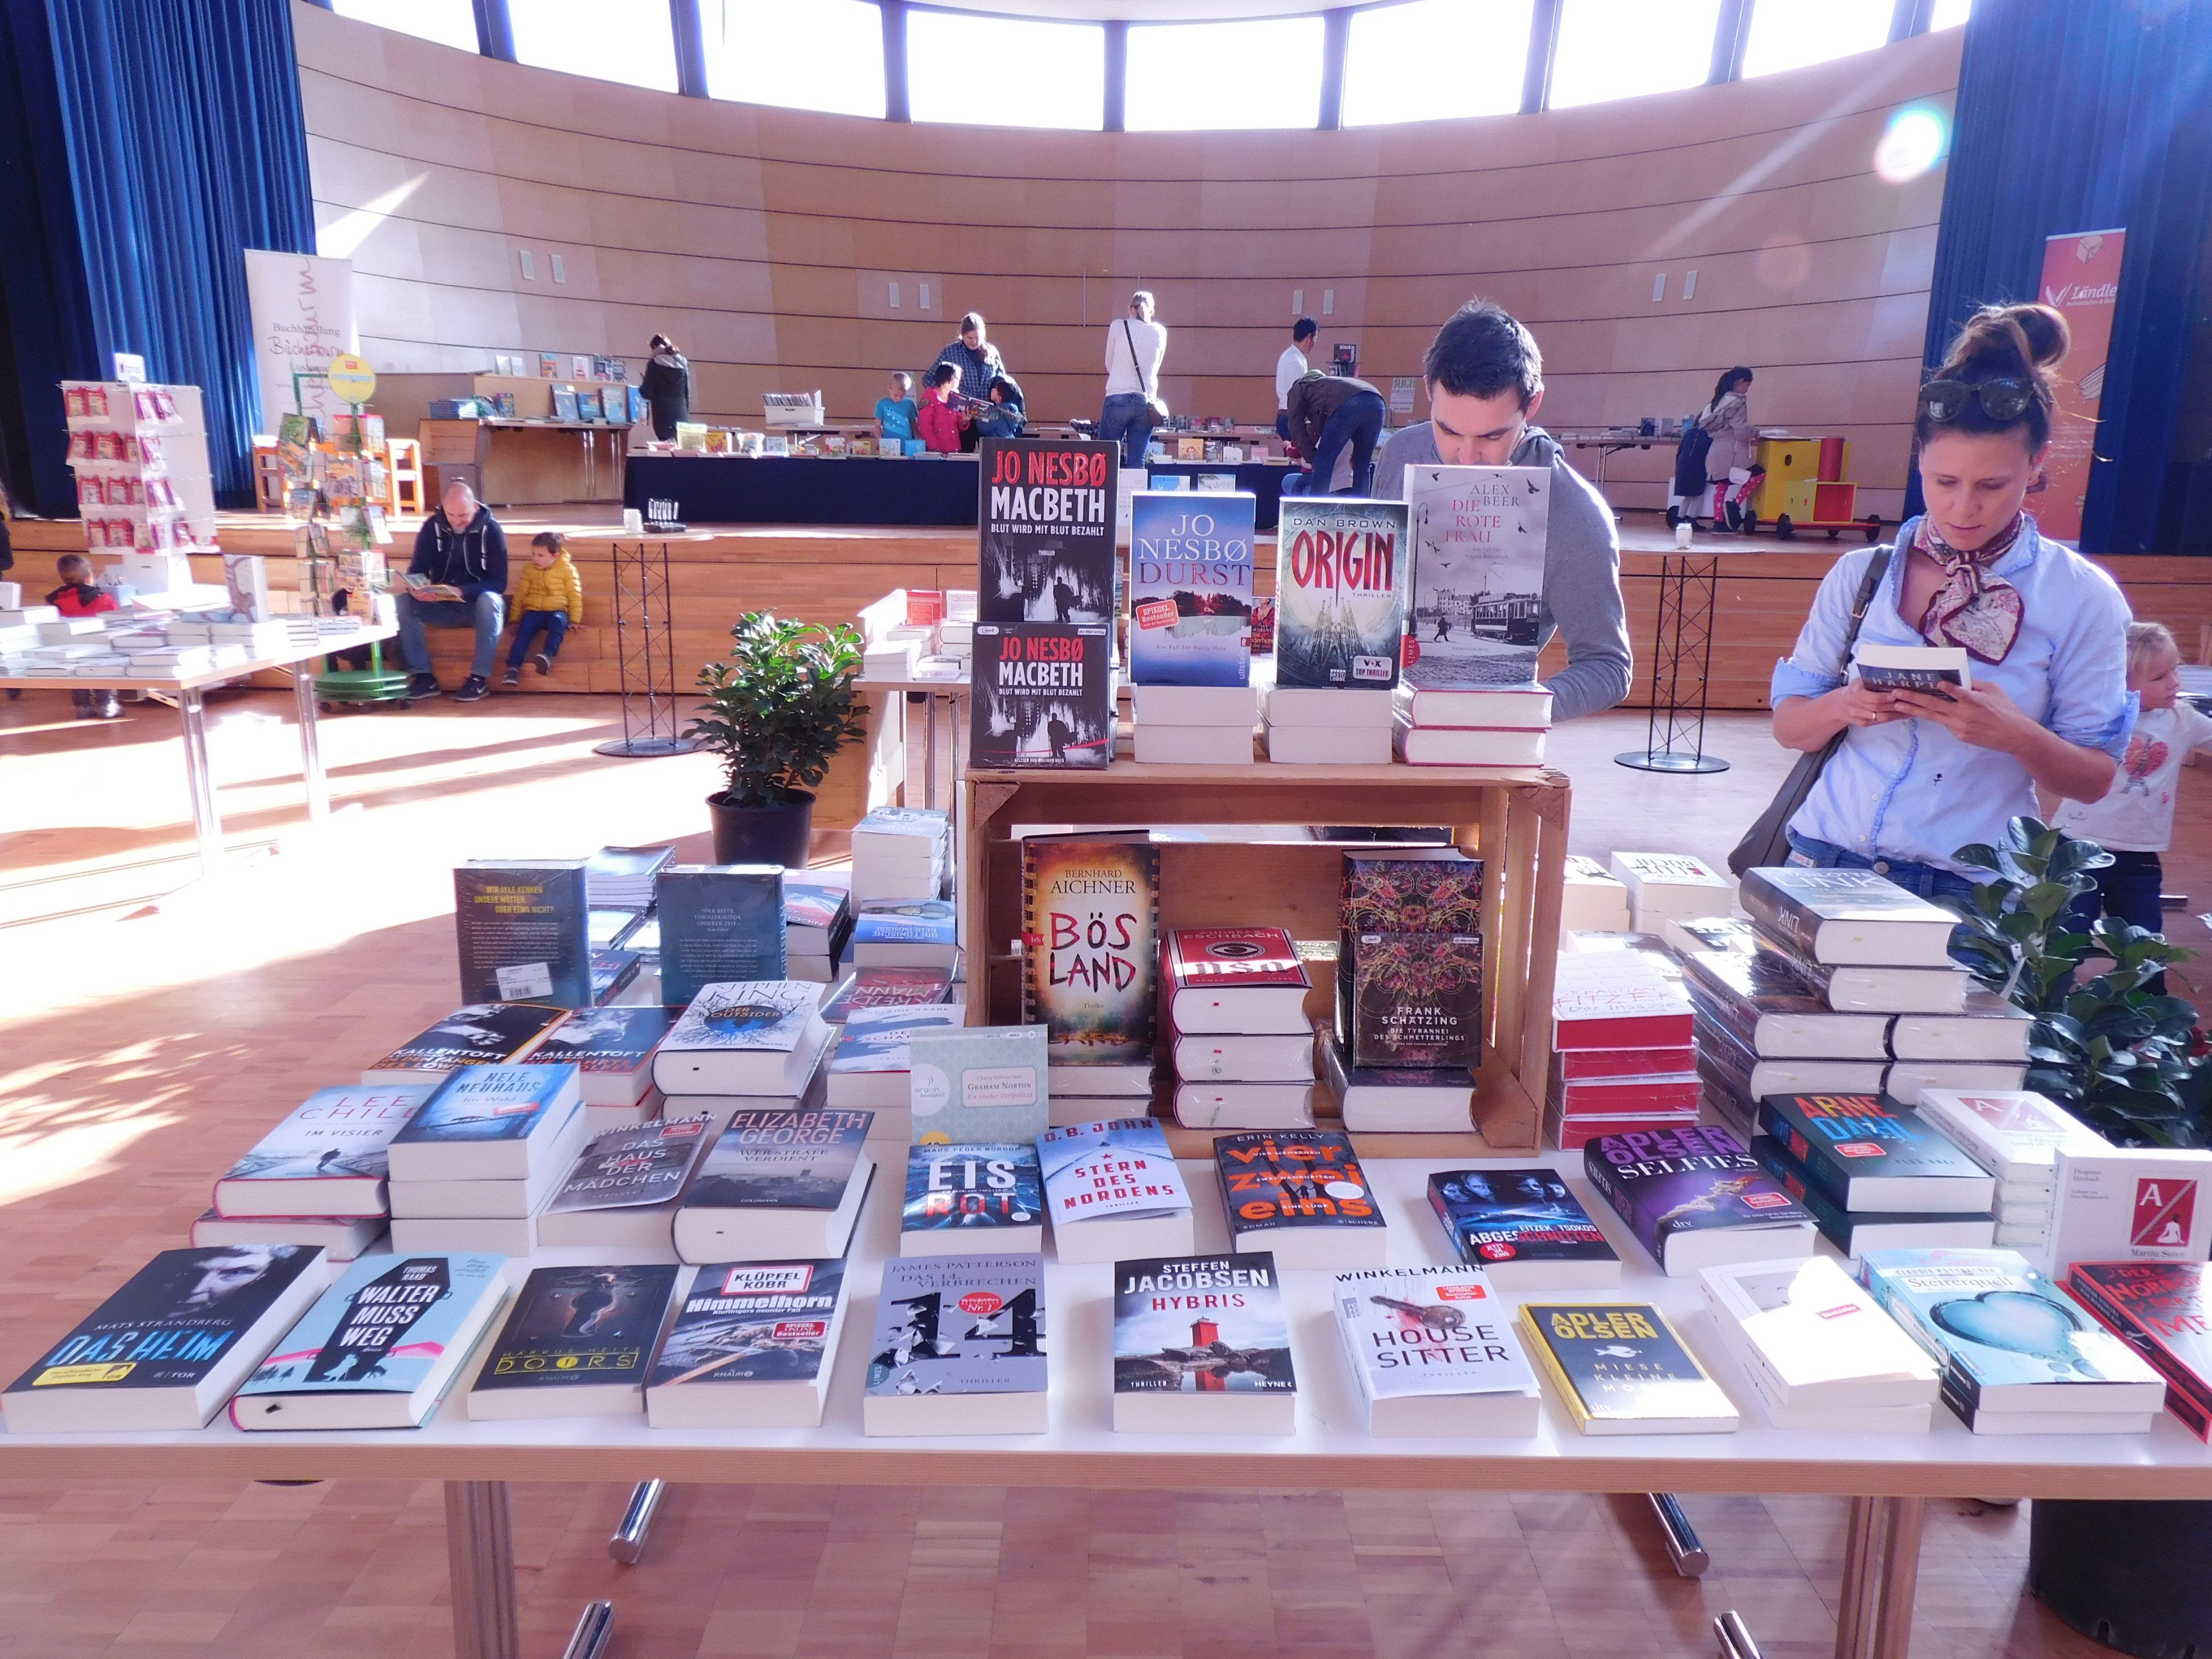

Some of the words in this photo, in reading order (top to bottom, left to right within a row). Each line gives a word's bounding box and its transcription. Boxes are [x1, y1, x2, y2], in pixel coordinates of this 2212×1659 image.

[2071, 284, 2117, 300] Ländle
[273, 323, 340, 336] Buchhandlung
[991, 450, 1021, 484] JO
[1028, 451, 1107, 487] NESBØ
[1471, 484, 1510, 495] ALEX
[991, 486, 1105, 523] MACBETH
[1453, 499, 1480, 512] DIE
[1483, 496, 1520, 507] BEER
[1171, 514, 1215, 537] JO
[1293, 518, 1326, 527] DAN
[1337, 519, 1395, 529] BROWN
[1456, 515, 1501, 528] ROTE
[991, 524, 1009, 534] BLUT
[1012, 524, 1033, 535] WIRD
[1035, 525, 1048, 535] MIT
[1050, 525, 1069, 535] BLUT
[1071, 526, 1104, 536] BEZAHLT
[1445, 530, 1492, 543] FRAU
[1137, 538, 1247, 563] NESBØ
[1139, 563, 1251, 586] DURST
[1291, 529, 1395, 606] ORIGIN
[1142, 611, 1174, 623] Bestseller
[1143, 604, 1170, 616] SPIEGEL
[999, 637, 1021, 660] JO
[1027, 637, 1084, 662] NESBØ
[999, 662, 1083, 687] MACBETH
[1885, 672, 1935, 682] JANE
[1872, 677, 1939, 689] HARPE
[1065, 869, 1122, 878] BERNHARD
[1050, 880, 1137, 895] AICHNER
[1773, 877, 1893, 888] LINK
[1049, 912, 1138, 950] BÖS
[1049, 952, 1137, 994] LAND
[717, 982, 813, 990] STEPHEN
[708, 990, 810, 1001] KING
[1397, 1007, 1442, 1016] FRANK
[1391, 1034, 1466, 1042] SCHMETTERLINGS
[390, 1049, 508, 1060] KALLENTOFT
[483, 1072, 531, 1082] NELE
[454, 1082, 542, 1094] NEUHAUS
[336, 1096, 415, 1108] LEE
[1793, 1096, 1899, 1119] ARNE
[594, 1113, 718, 1138] WINKELMANN
[731, 1110, 867, 1129] ELIZABETH
[1092, 1119, 1154, 1133] JOHN
[739, 1127, 846, 1145] GEORGE
[1810, 1116, 1925, 1141] DAHL
[621, 1138, 665, 1151] DAS
[1236, 1134, 1272, 1142] ERIN
[1600, 1125, 1730, 1152] ADLER
[605, 1149, 667, 1163] HAUS
[1226, 1140, 1343, 1164] vier
[1604, 1139, 1748, 1165] OLSEN
[605, 1162, 653, 1176] DER
[1075, 1160, 1148, 1178] STERN
[1617, 1154, 1759, 1180] SELFIES
[563, 1171, 682, 1194] MÄDCHEN
[928, 1161, 1016, 1191] EIS
[1093, 1174, 1137, 1189] DES
[1228, 1163, 1364, 1192] zwei
[1063, 1184, 1175, 1210] NORDENS
[2139, 1183, 2163, 1208] A
[926, 1192, 1016, 1218] ROT
[1239, 1192, 1372, 1220] eins
[1557, 1224, 1597, 1232] TSOKOS
[1672, 1219, 1692, 1229] dtv
[403, 1264, 437, 1274] THOMAS
[892, 1263, 941, 1273] JAMES
[946, 1259, 1036, 1270] PATTERSON
[1162, 1261, 1230, 1274] STEFFEN
[1335, 1264, 1485, 1282] WINKELMANN
[734, 1271, 802, 1283] KLÜPFEL
[901, 1273, 934, 1283] DAS
[918, 1277, 1037, 1289] VERBRECHEN
[1123, 1269, 1270, 1295] JACOBSEN
[1907, 1275, 2014, 1288] Steirerquell
[743, 1280, 788, 1290] KOBR
[357, 1285, 441, 1305] WALTER
[1152, 1293, 1246, 1311] HYBRIS
[685, 1295, 834, 1313] Himmelhorn
[350, 1305, 420, 1325] MUSS
[1550, 1312, 1648, 1327] ADLER
[93, 1321, 134, 1332] MATS
[136, 1318, 233, 1329] STRANDBERG
[1553, 1325, 1660, 1339] OLSEN
[340, 1326, 394, 1347] WEG
[1372, 1325, 1500, 1348] HOUSE
[43, 1331, 139, 1367] DAS
[127, 1329, 234, 1361] HEIM
[1377, 1345, 1511, 1369] SITTER
[1594, 1363, 1664, 1371] MIESE
[873, 1365, 882, 1386] LIMES
[1594, 1373, 1678, 1381] KLEINE
